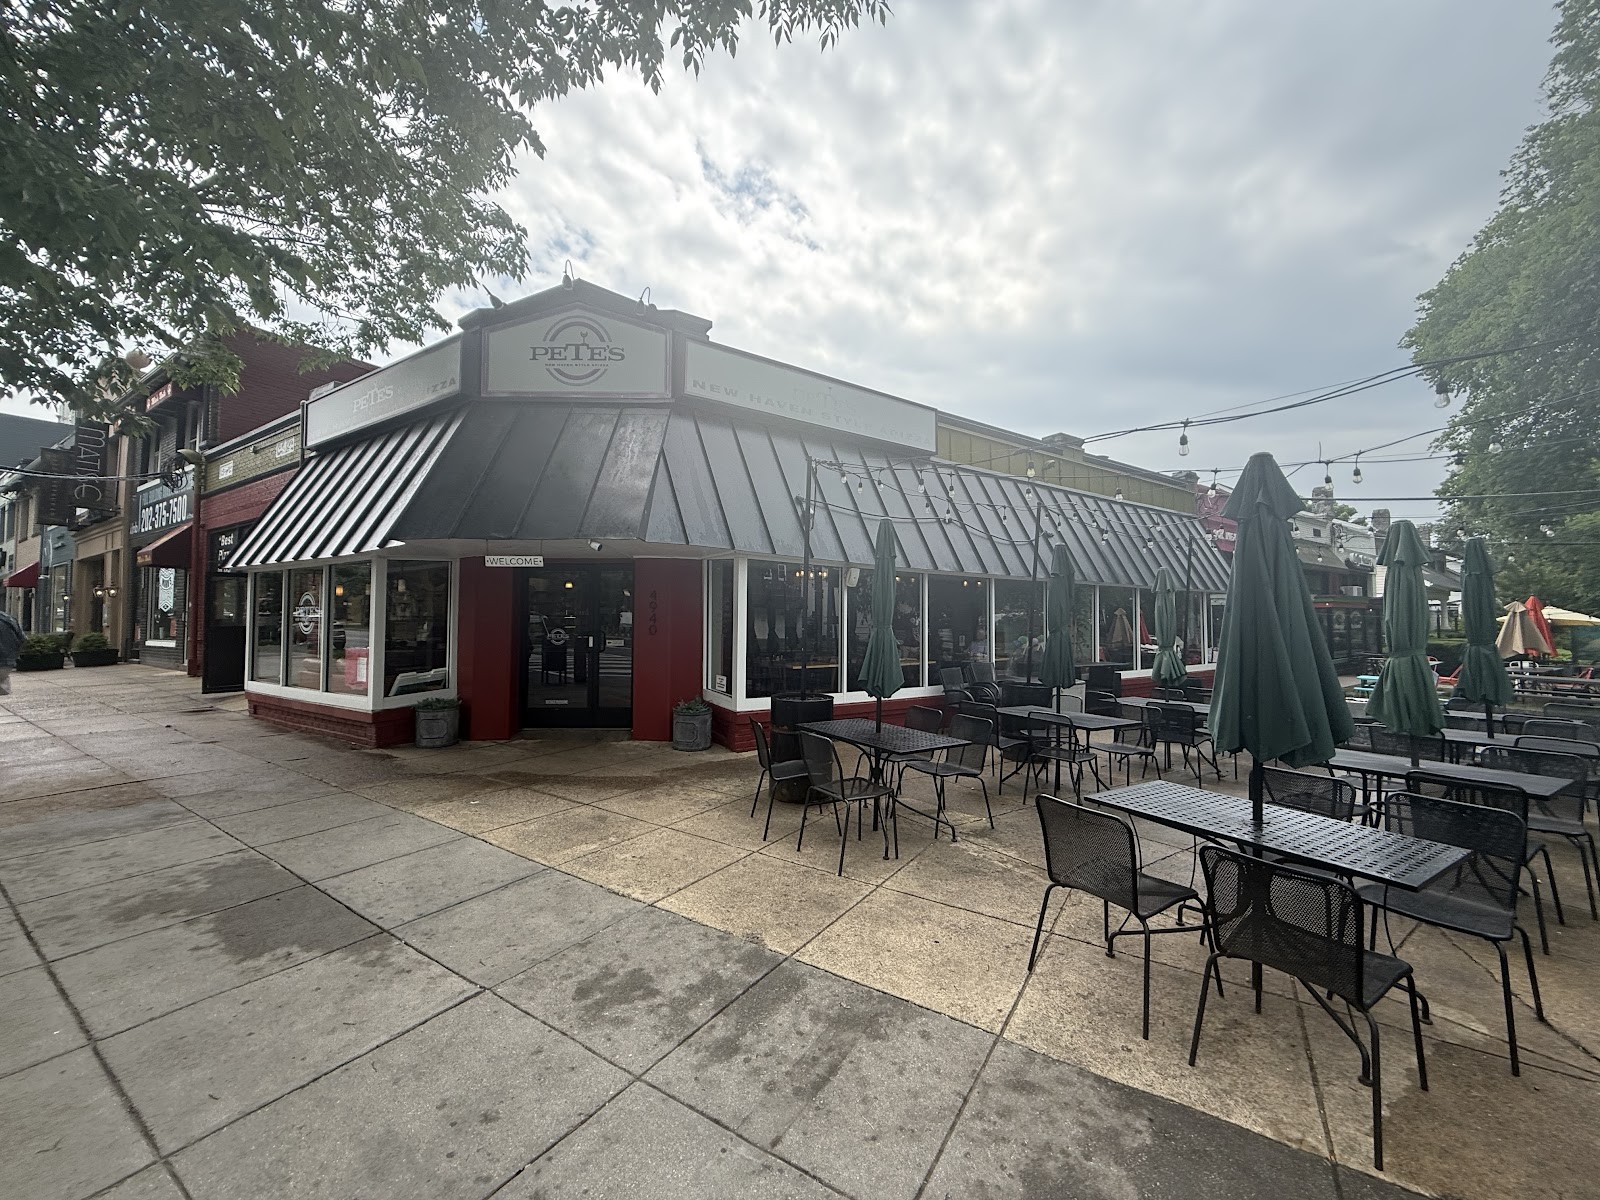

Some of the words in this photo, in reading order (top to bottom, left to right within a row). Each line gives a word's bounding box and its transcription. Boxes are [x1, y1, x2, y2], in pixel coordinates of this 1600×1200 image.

[529, 343, 625, 361] PETE'S
[692, 379, 738, 397] NEW
[749, 393, 811, 416] HAVEN
[141, 494, 187, 533] 202-375-7500
[489, 557, 539, 566] WELCOME
